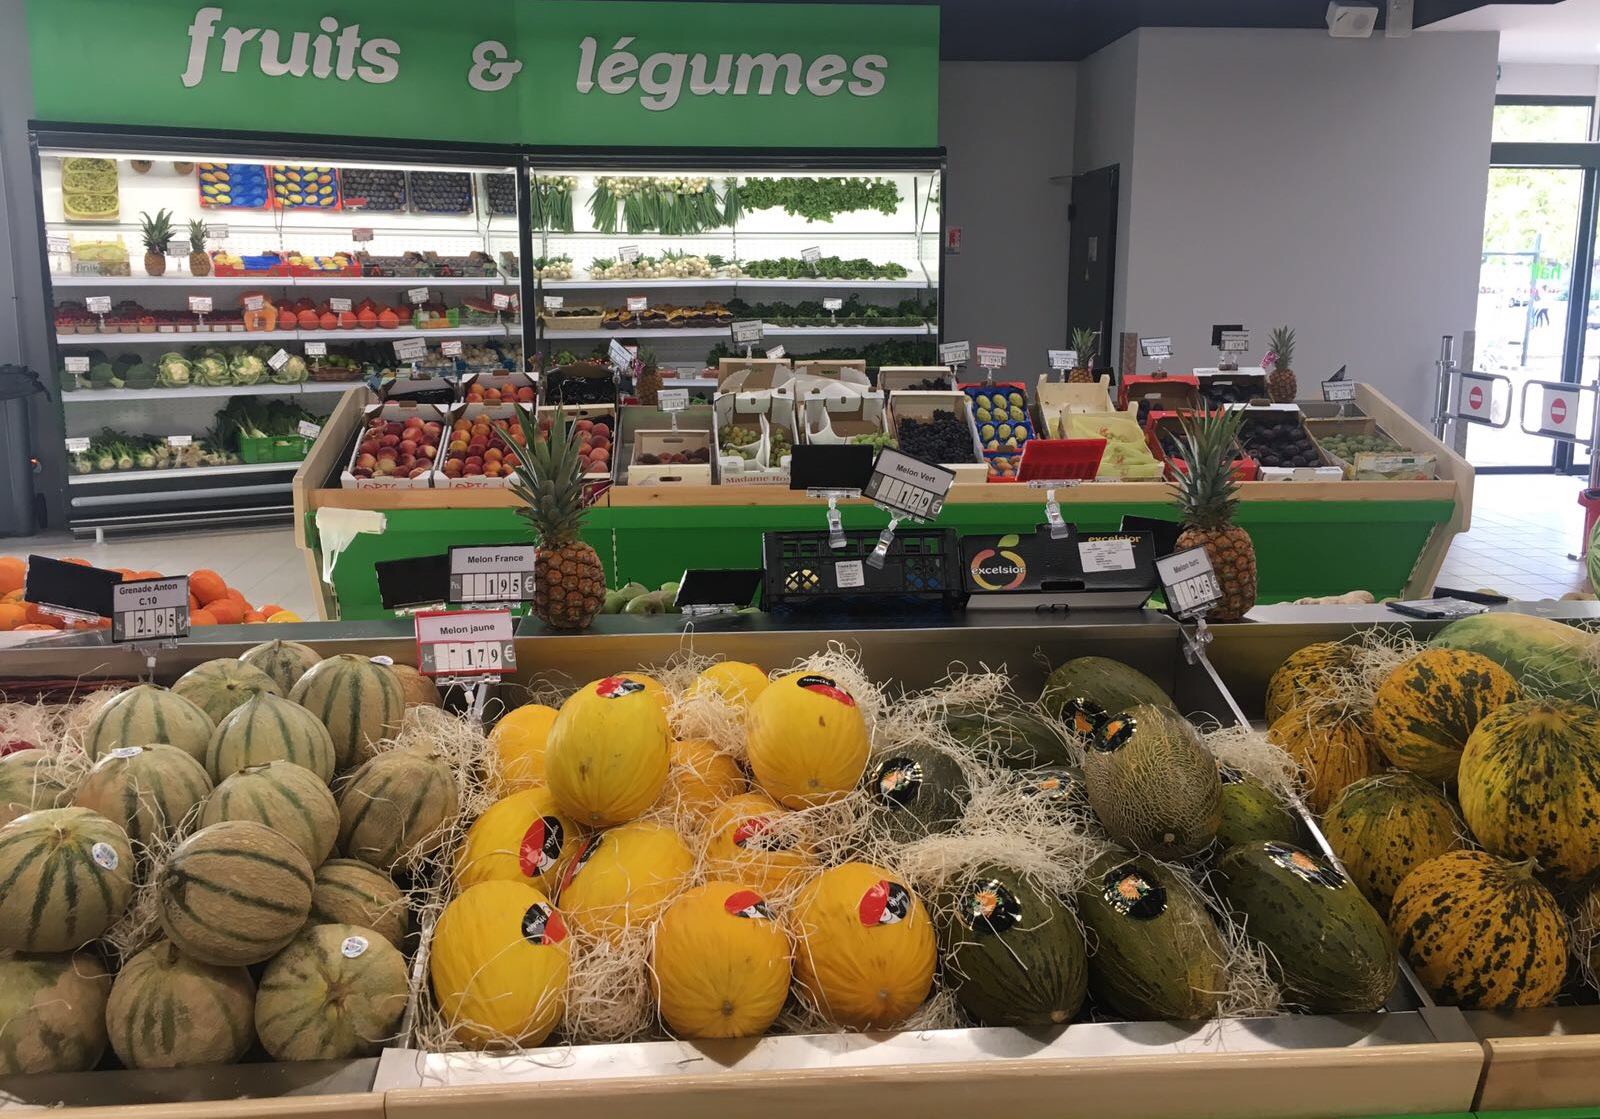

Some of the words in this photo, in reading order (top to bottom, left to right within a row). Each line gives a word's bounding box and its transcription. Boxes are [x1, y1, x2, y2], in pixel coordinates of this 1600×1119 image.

[181, 7, 401, 88] fruits
[468, 40, 523, 92] &
[576, 36, 888, 112] légumes
[895, 463, 919, 477] Melon
[920, 470, 936, 483] Vert
[467, 555, 493, 564] Melon
[494, 554, 524, 562] France
[971, 564, 1026, 576] excelsior
[1172, 562, 1190, 574] Melon
[119, 586, 153, 595] Grenade
[153, 583, 178, 592] Anton
[138, 596, 158, 606] C.10
[440, 625, 468, 635] Melon
[469, 622, 496, 634] jaune
